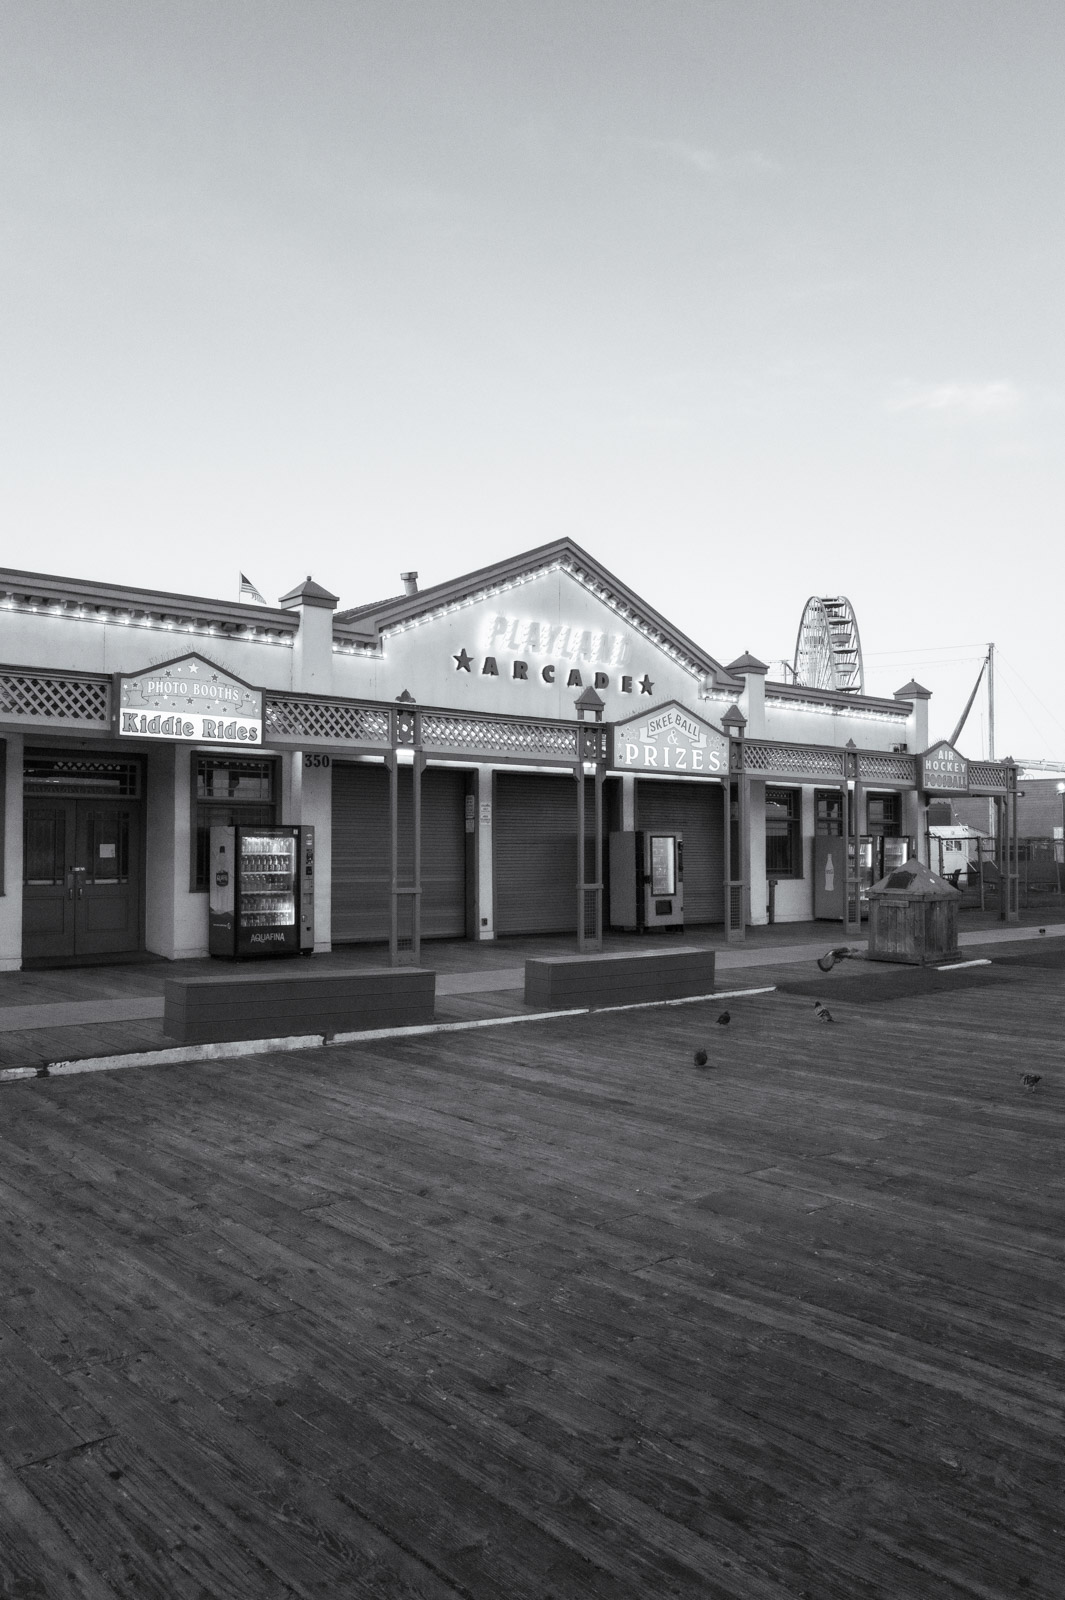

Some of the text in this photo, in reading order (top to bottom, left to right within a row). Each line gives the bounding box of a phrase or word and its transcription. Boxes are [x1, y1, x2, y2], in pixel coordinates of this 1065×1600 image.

[485, 615, 632, 667] PLAYLAND
[482, 656, 633, 693] ARCADE
[148, 681, 239, 701] PHOTO BOOTHS
[122, 712, 258, 741] Kiddie Rides
[649, 713, 698, 736] SKEE BALL
[667, 729, 679, 745] &
[304, 754, 330, 768] 350
[625, 743, 721, 771] PRIZES
[938, 750, 954, 760] AIR
[925, 760, 966, 773] HOCKEY
[924, 773, 967, 789] FOOSBALL
[250, 932, 285, 943] AQUAFINA
